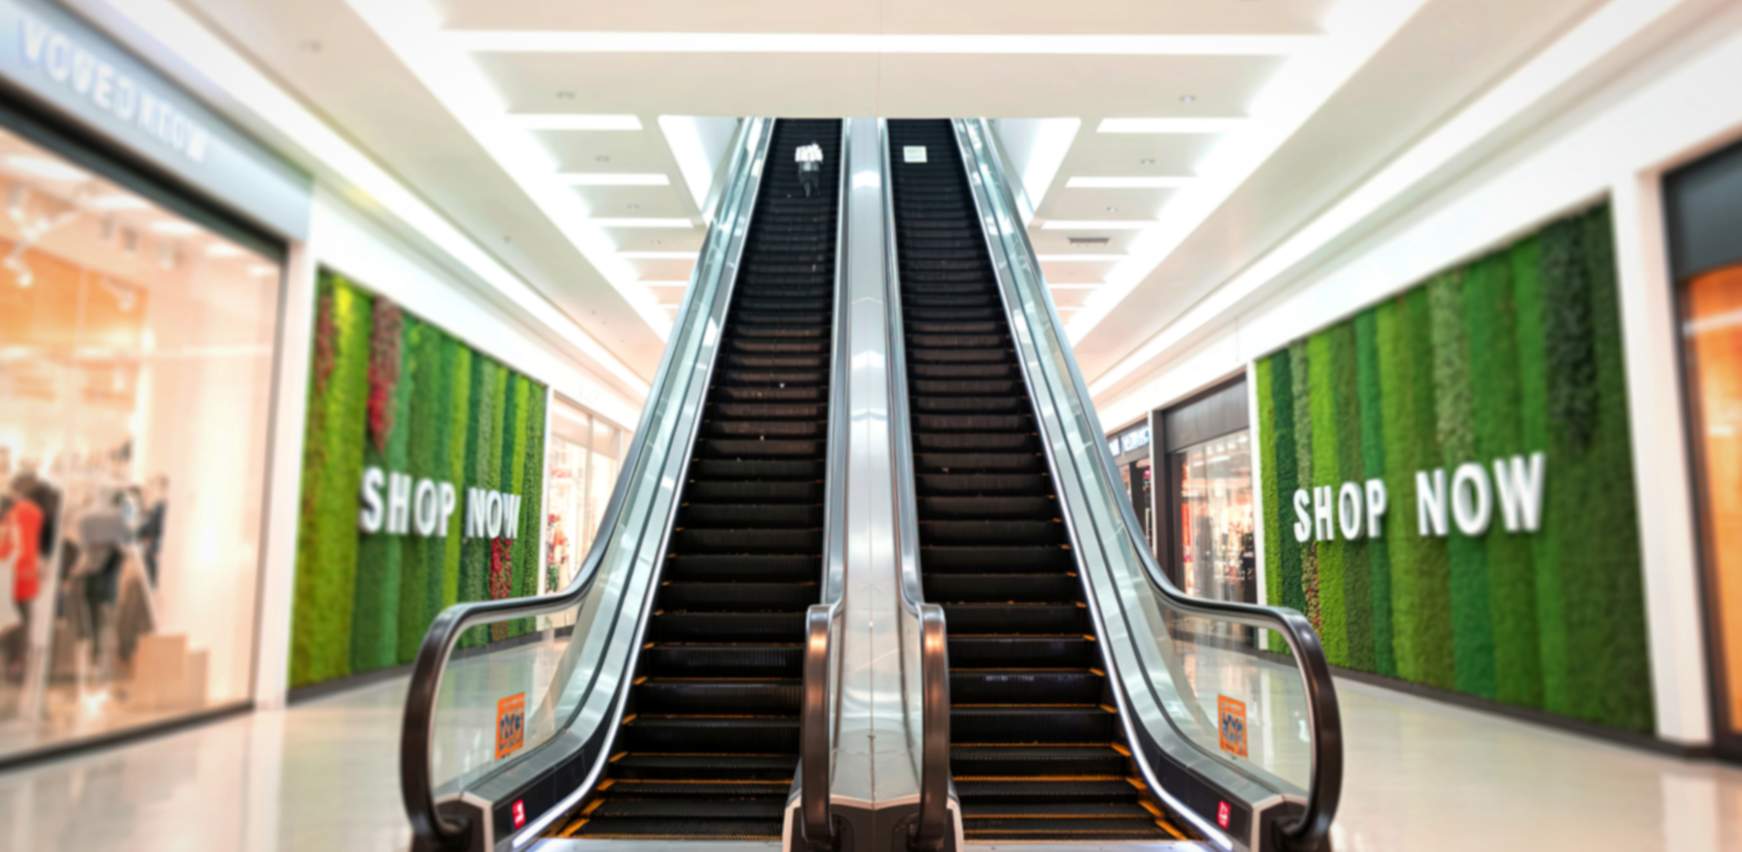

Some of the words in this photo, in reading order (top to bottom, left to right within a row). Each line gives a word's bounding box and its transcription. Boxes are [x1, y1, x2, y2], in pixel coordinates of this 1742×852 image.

[360, 466, 456, 538] SHOP
[465, 487, 522, 539] NOW
[1293, 478, 1387, 543] SHOP
[1415, 451, 1546, 536] NOW
